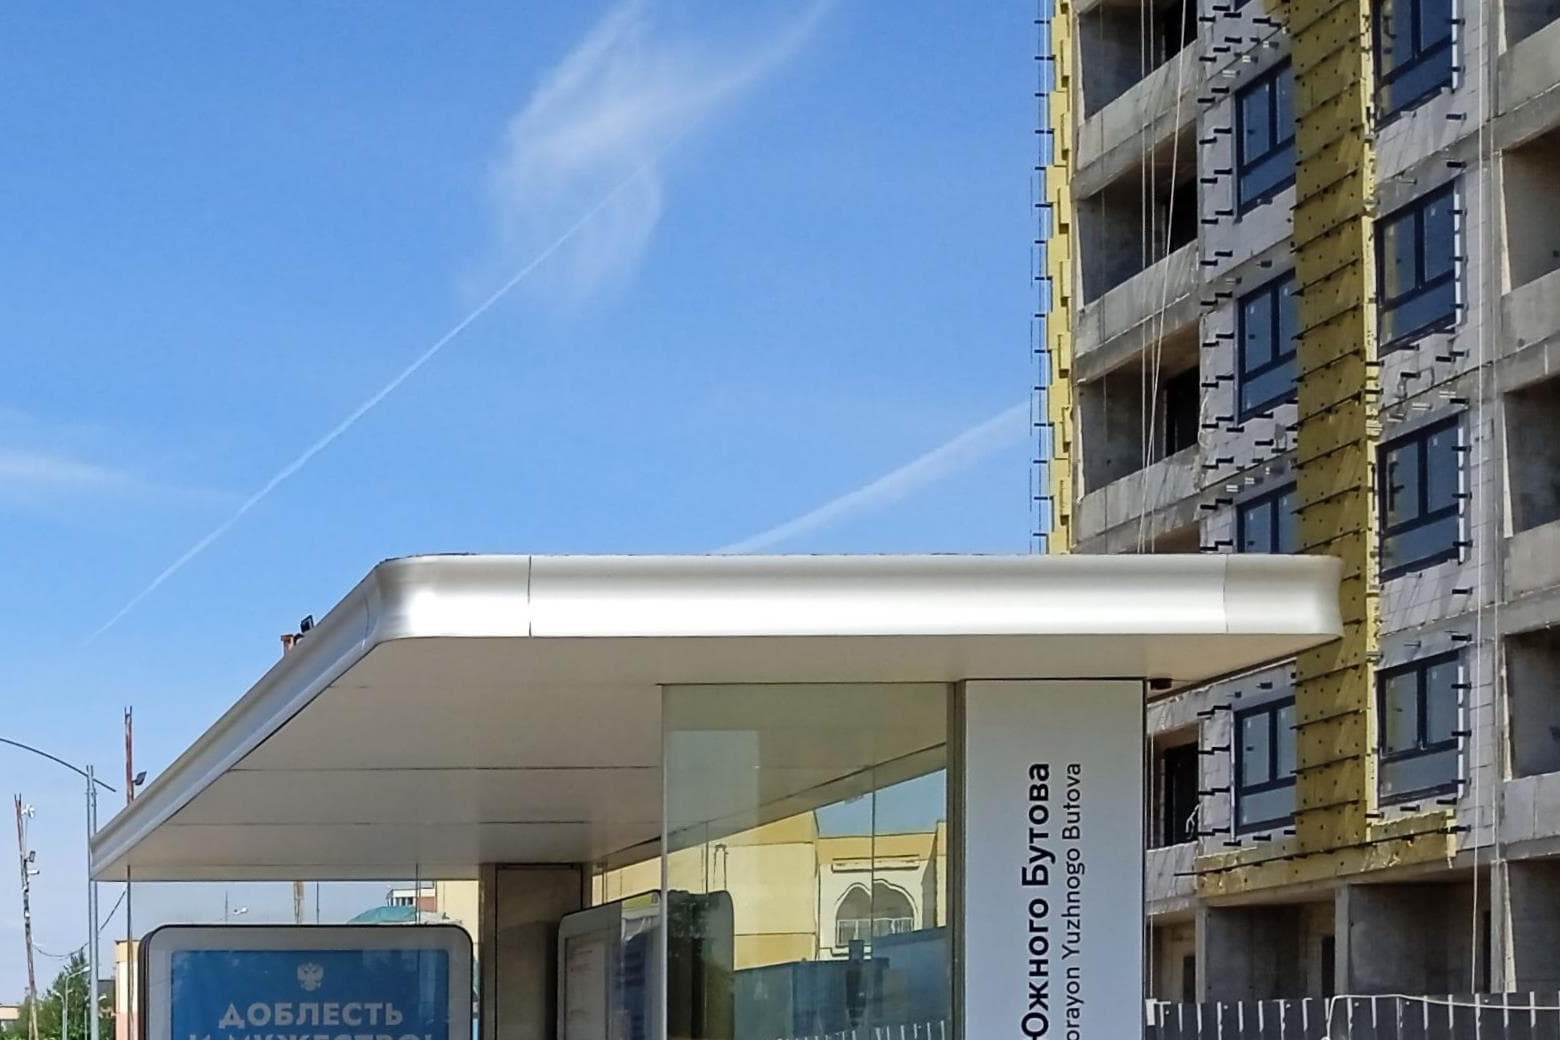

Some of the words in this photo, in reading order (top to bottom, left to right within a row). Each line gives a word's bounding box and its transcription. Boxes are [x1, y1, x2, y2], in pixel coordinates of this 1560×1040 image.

[1021, 763, 1055, 887] Бутова
[1062, 763, 1080, 839] Butova
[1061, 847, 1086, 960] Yuzhnogo
[218, 1002, 404, 1029] ДОБЛЕСТЬ
